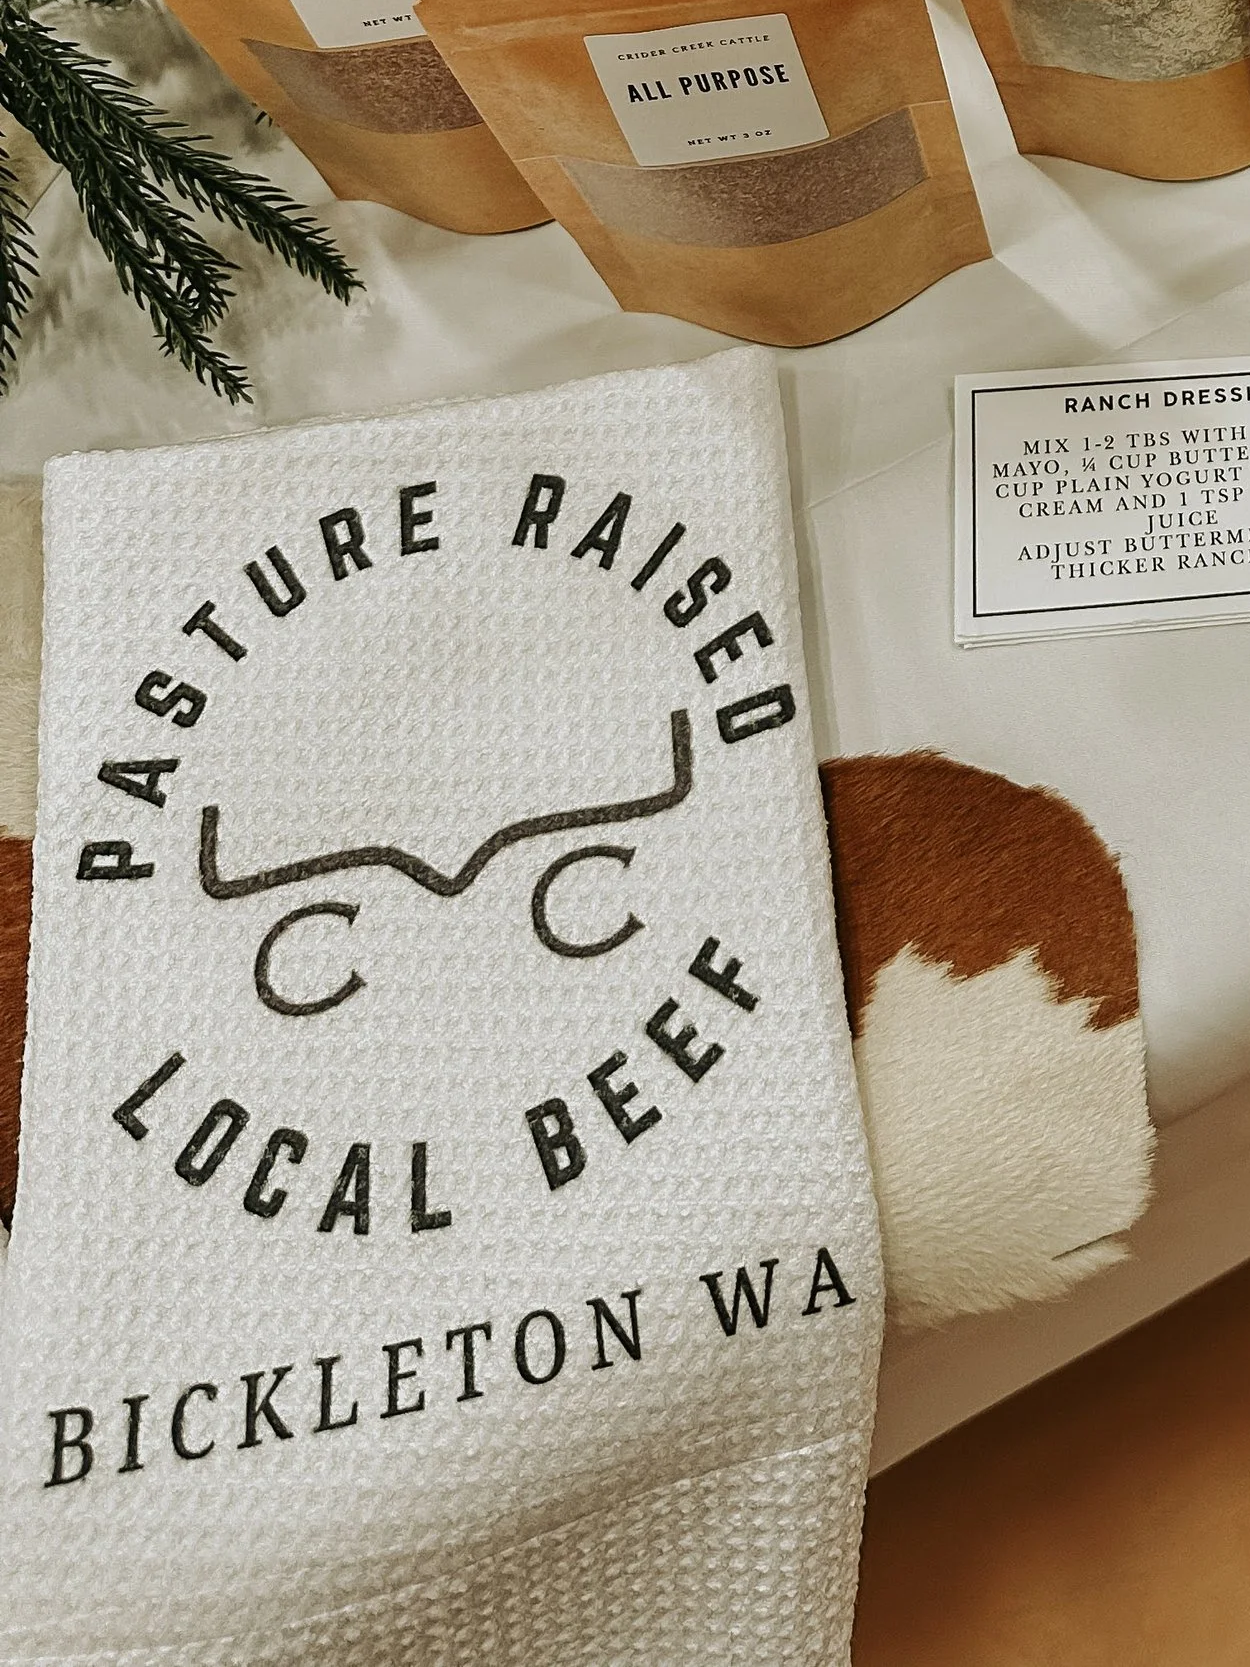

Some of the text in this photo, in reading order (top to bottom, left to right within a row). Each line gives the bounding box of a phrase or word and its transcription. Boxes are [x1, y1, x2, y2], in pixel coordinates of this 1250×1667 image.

[618, 35, 770, 61] CRIDER CREEK CATTLE
[627, 64, 790, 103] ALL PURPOSE
[1064, 393, 1151, 414] RANCH
[1023, 439, 1070, 456] MIX
[1083, 436, 1115, 452] 1-2
[1126, 432, 1170, 449] TBS
[1181, 425, 1247, 444] WITH
[992, 459, 1070, 479] MAYO,
[1109, 453, 1157, 471] CUP
[995, 482, 1045, 499] CUP
[1056, 475, 1131, 496] PLAIN
[1141, 467, 1243, 489] YOGURT
[1018, 499, 1104, 518] CREAM
[1115, 494, 1167, 511] AND
[1179, 492, 1188, 506] 1
[1201, 487, 1245, 505] TSP
[1145, 510, 1219, 535] JUICE
[1017, 540, 1113, 563] ADJUST
[1051, 555, 1166, 580] THICKER
[511, 472, 796, 744] RAISED
[76, 481, 440, 882] PASTURE
[112, 937, 759, 1236] LOCAL BEEF
[45, 1246, 857, 1489] BICKLETON WA
